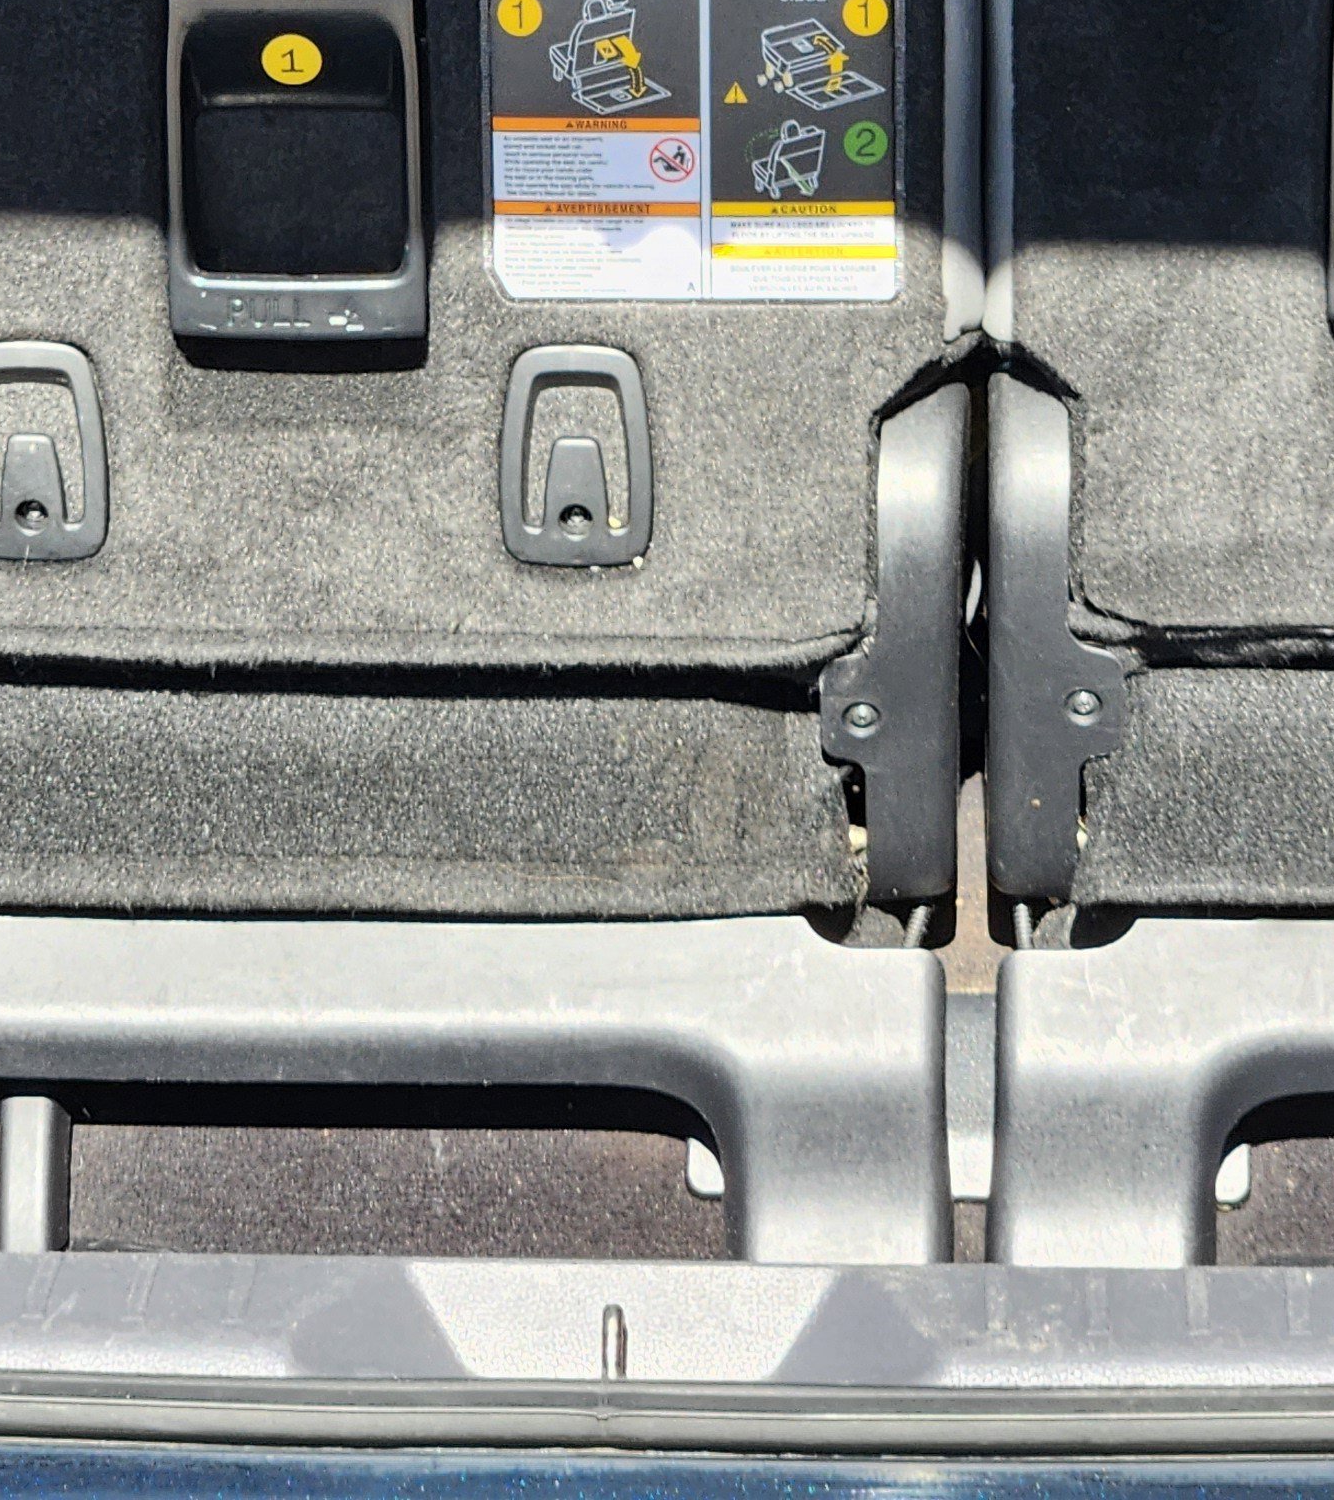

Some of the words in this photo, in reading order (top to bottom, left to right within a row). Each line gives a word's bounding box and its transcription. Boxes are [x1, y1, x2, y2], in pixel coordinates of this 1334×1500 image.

[512, 0, 525, 30] 1
[857, 0, 870, 29] 1
[280, 50, 305, 73] 1
[575, 119, 628, 130] WARNING
[856, 128, 877, 157] 2
[782, 205, 838, 215] CAUTION
[687, 281, 697, 292] A
